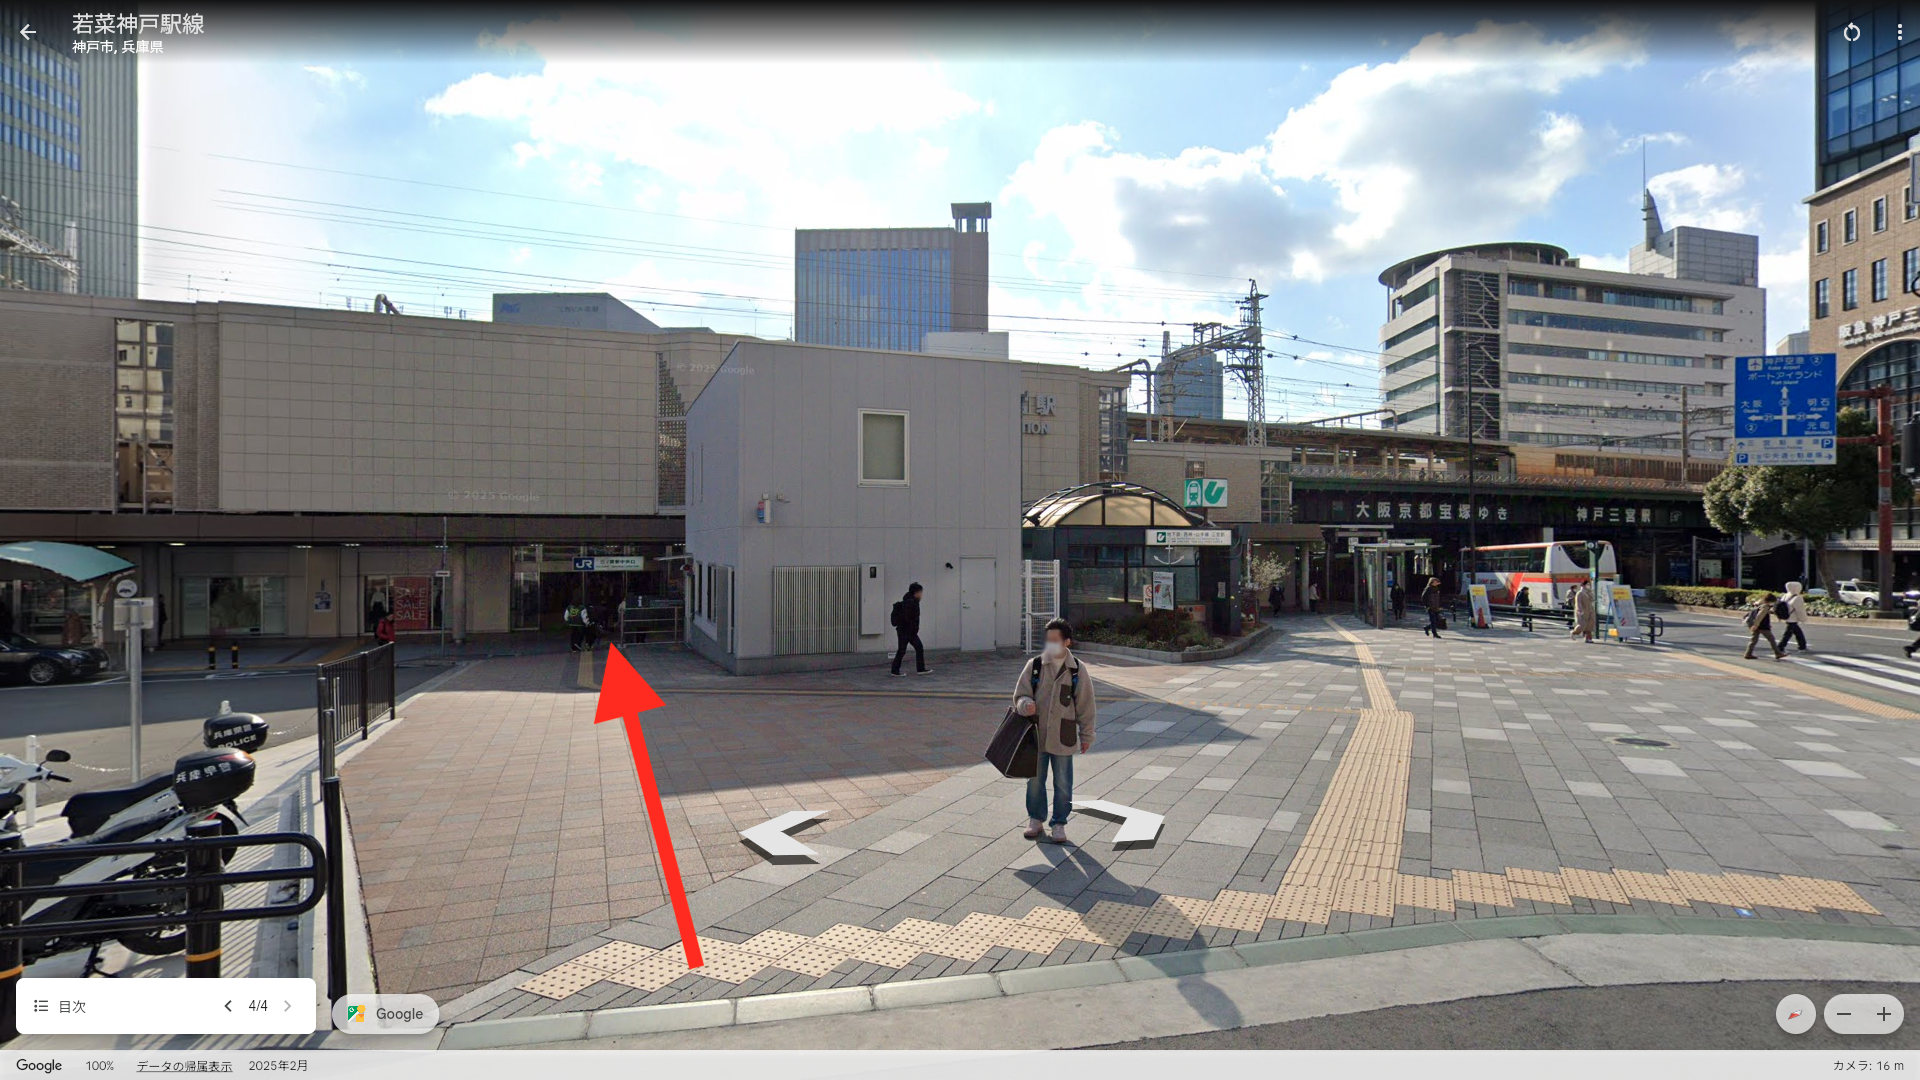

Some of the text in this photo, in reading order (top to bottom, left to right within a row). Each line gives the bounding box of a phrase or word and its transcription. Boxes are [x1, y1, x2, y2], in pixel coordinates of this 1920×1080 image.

[1765, 356, 1805, 366] 神戸空港
[1748, 371, 1822, 380] ポートアイランド
[1741, 400, 1762, 409] 大阪
[1807, 398, 1831, 407] 明石
[1807, 421, 1830, 430] 元町
[1356, 501, 1508, 521] 大阪京都宝塚ゆき
[1577, 506, 1651, 523] 神戸三宮駅
[575, 559, 593, 569] JR
[396, 600, 427, 609] SALE
[396, 611, 427, 620] SALE
[176, 762, 231, 783] 兵庫県警
